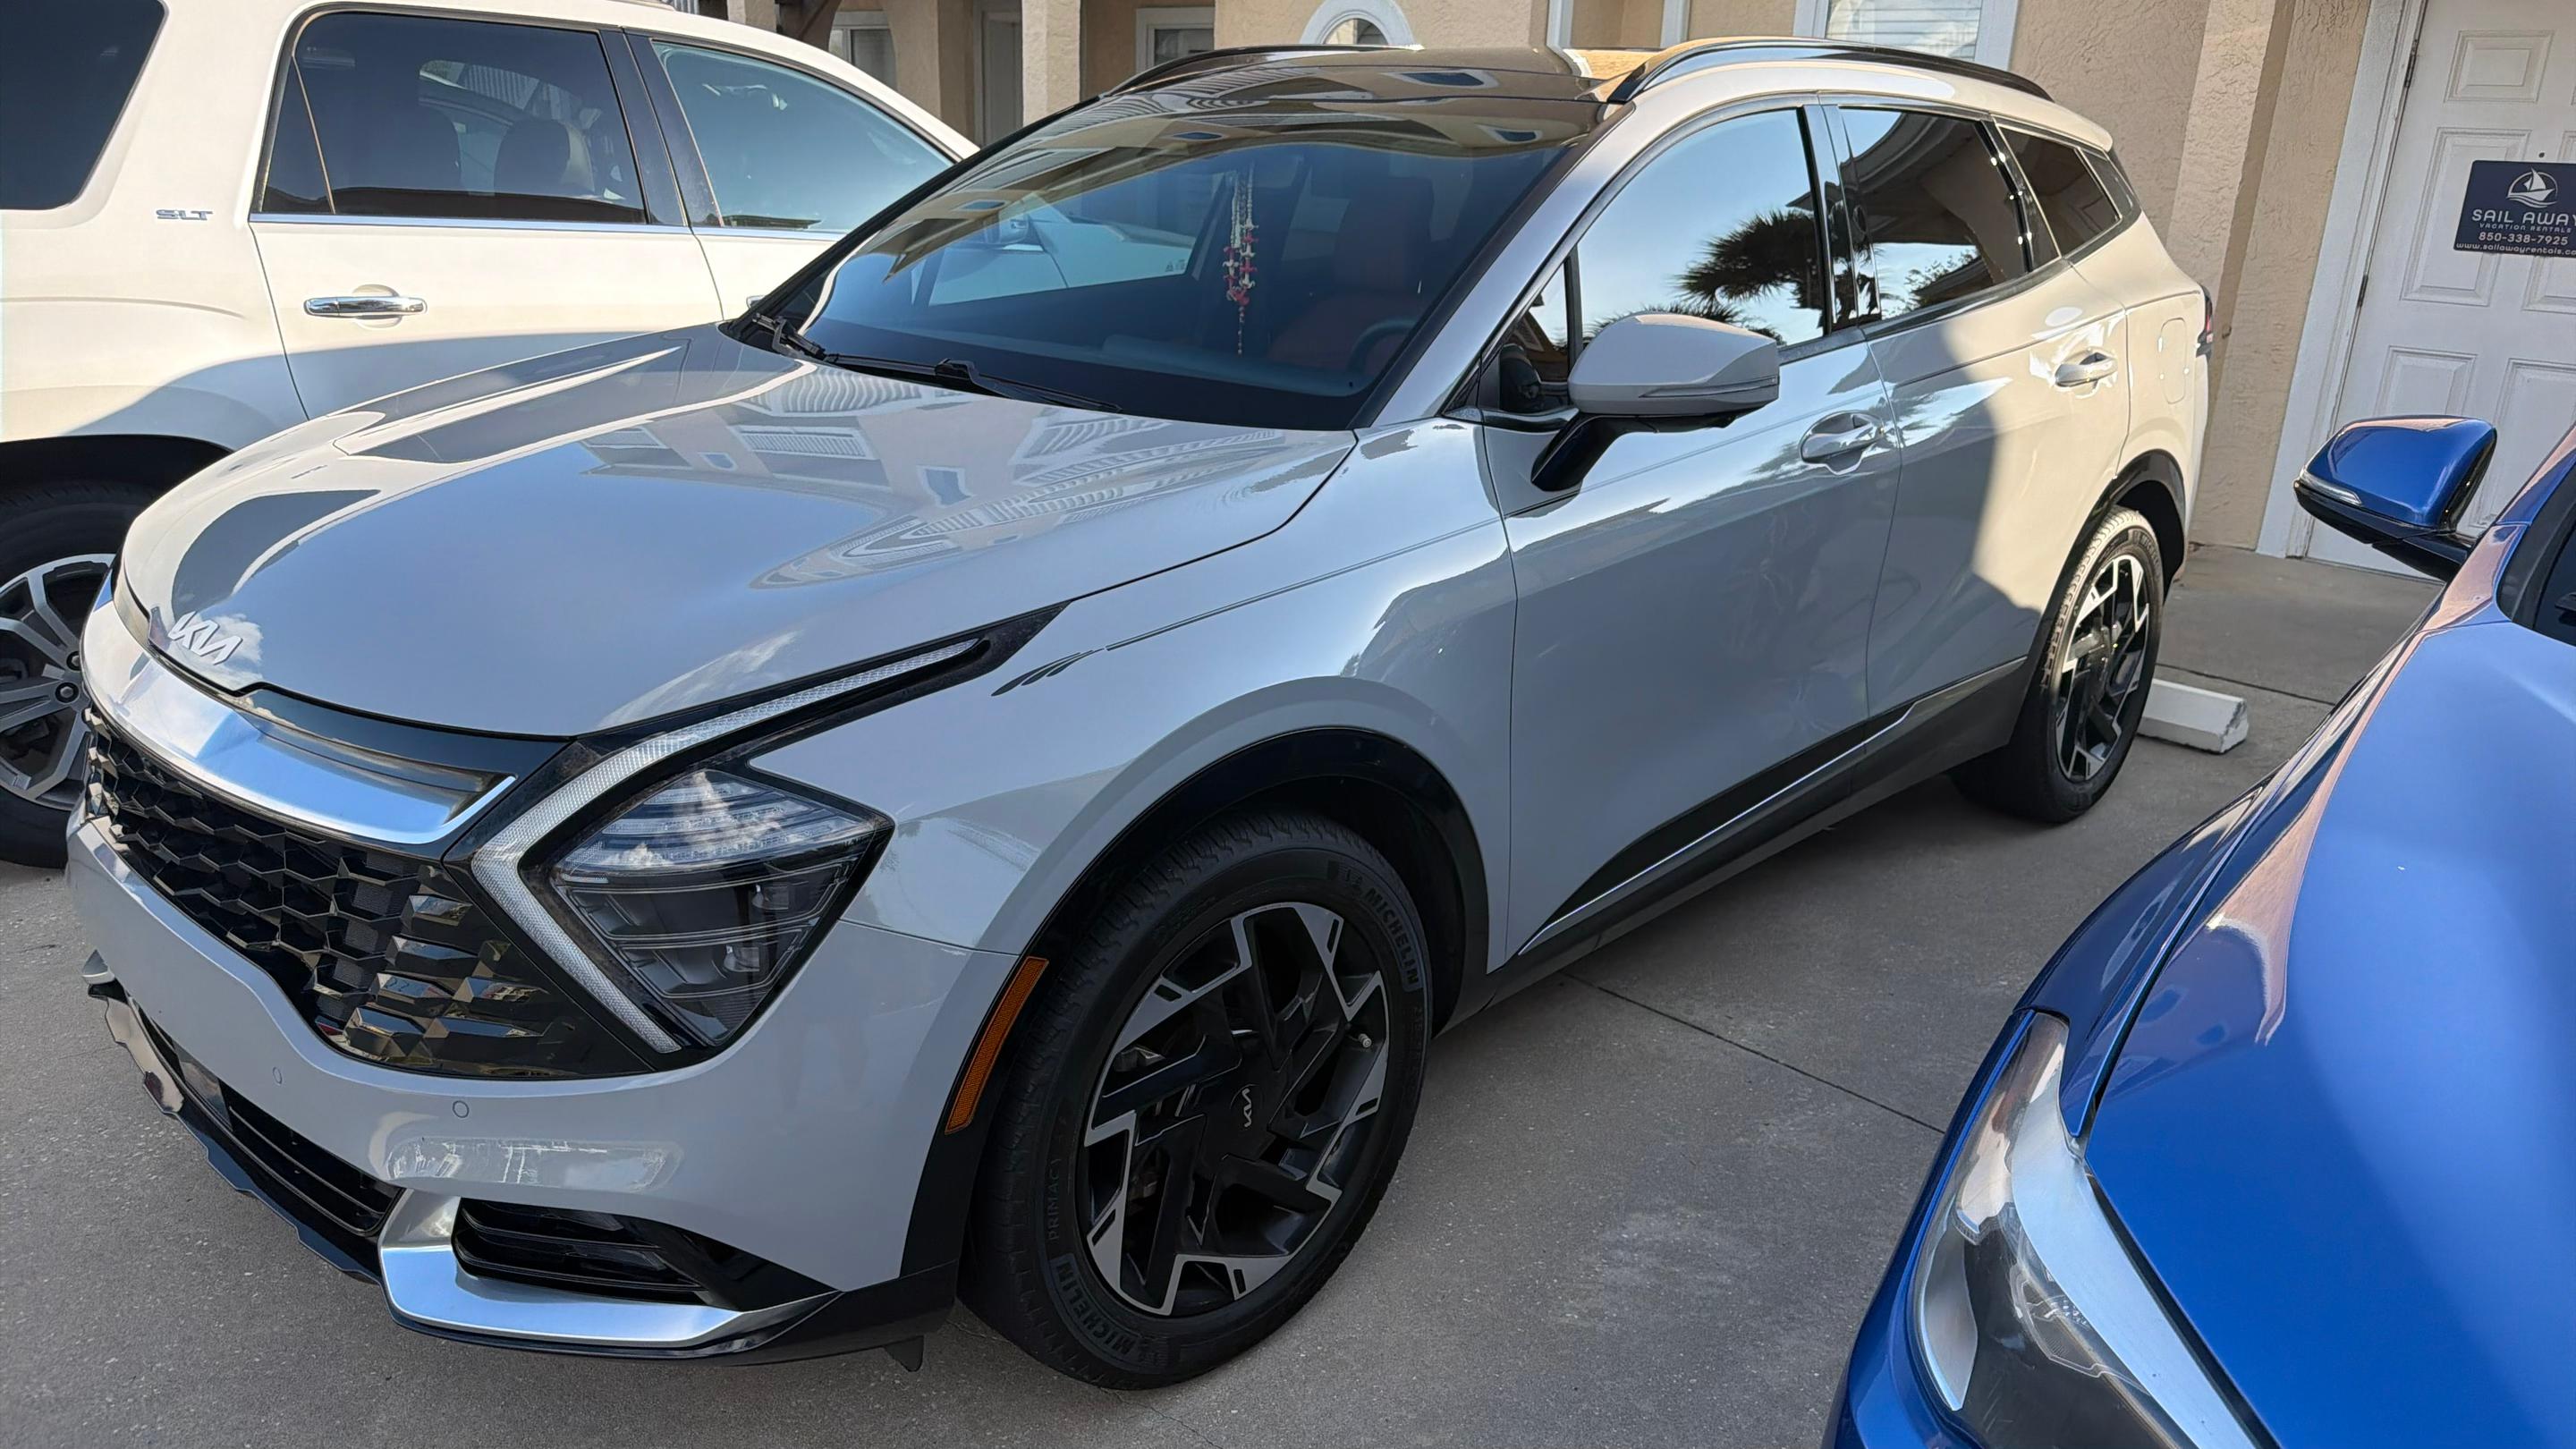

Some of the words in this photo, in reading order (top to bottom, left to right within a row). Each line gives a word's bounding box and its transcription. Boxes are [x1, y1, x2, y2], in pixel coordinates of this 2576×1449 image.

[156, 208, 214, 221] SLT
[2471, 208, 2514, 223] SAIL
[2479, 232, 2569, 245] 850-338-7925
[1364, 887, 1419, 985] MICHELIN
[1055, 1262, 1138, 1356] MICHELIN
